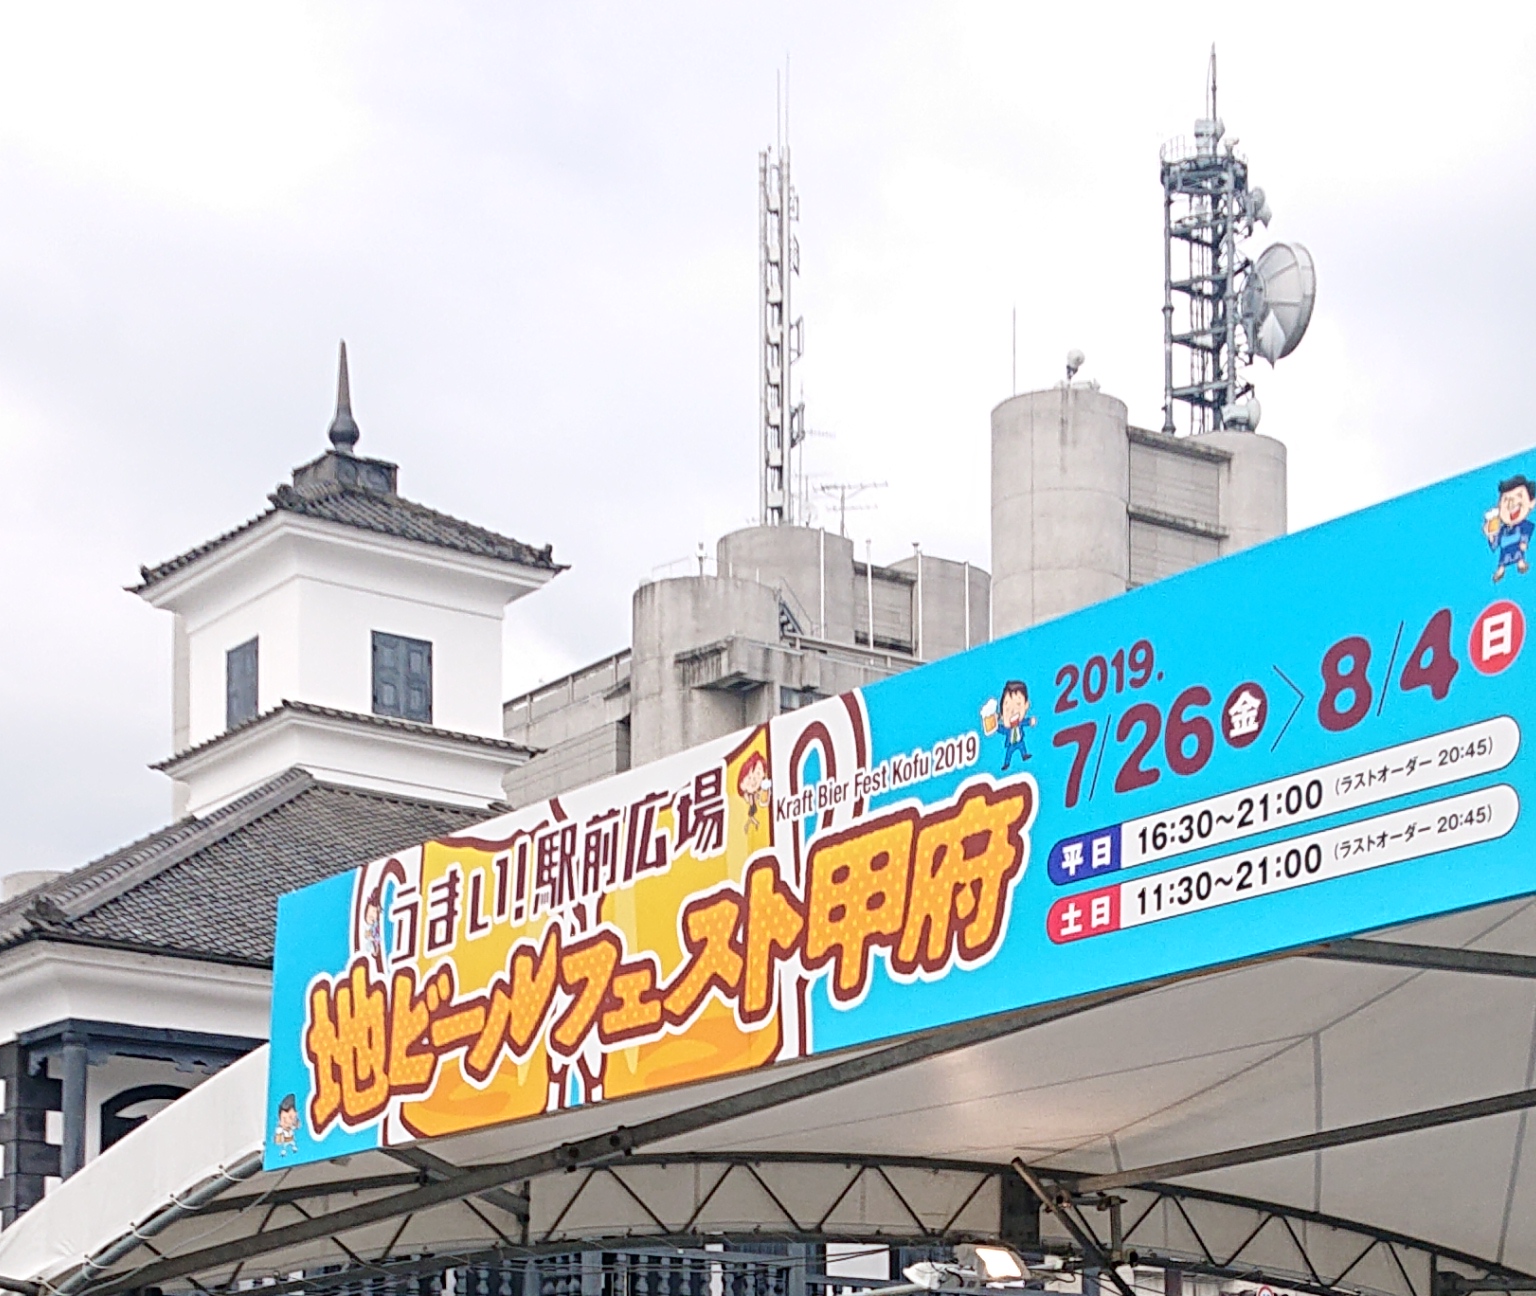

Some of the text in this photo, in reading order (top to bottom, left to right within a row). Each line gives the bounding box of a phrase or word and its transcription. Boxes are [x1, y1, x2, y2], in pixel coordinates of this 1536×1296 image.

[1054, 639, 1164, 714] 2019.
[1317, 608, 1460, 732] 8/4
[1481, 611, 1514, 662] 日
[776, 735, 977, 822] Kraft Bier Fest Kofu 2019
[1060, 838, 1113, 877] 平日
[304, 782, 1034, 1134] 地ビールフェスト甲府
[1059, 898, 1112, 937] 土日
